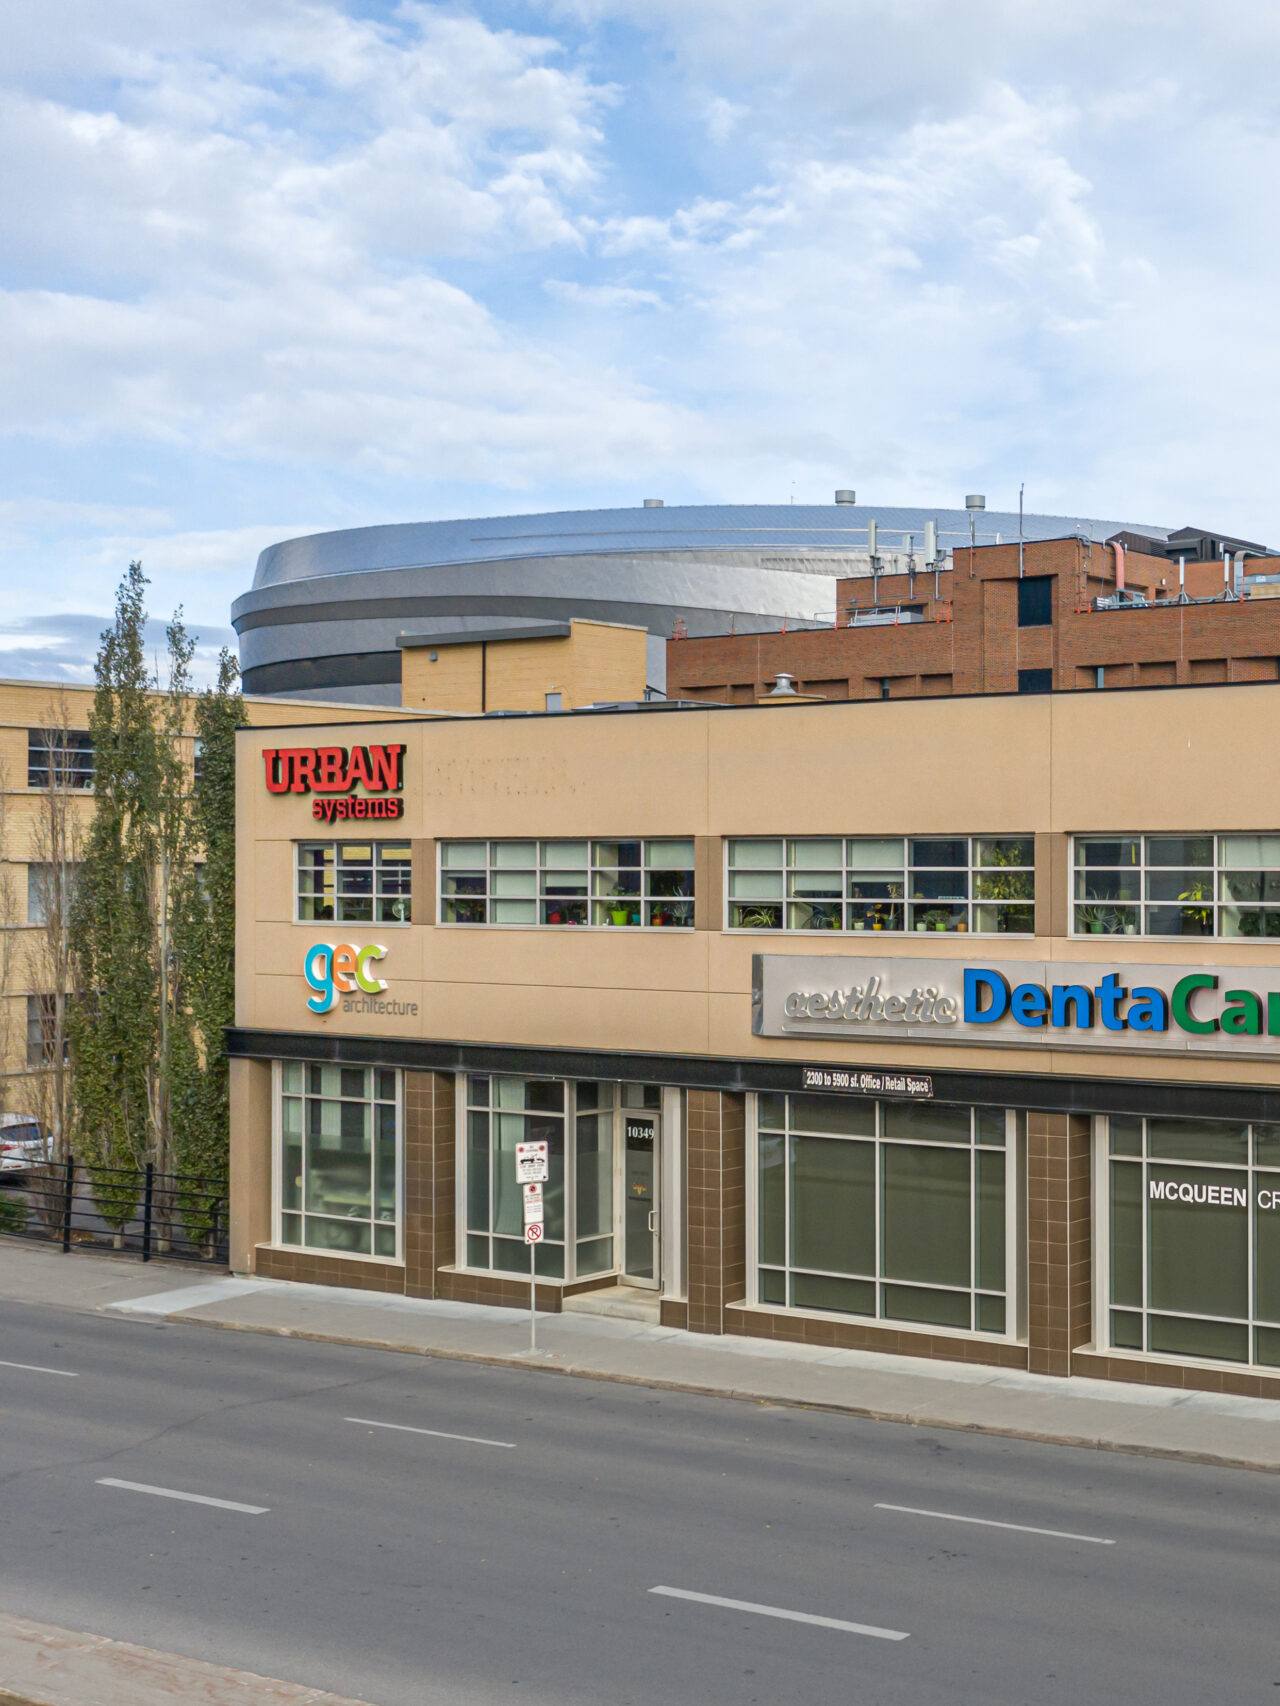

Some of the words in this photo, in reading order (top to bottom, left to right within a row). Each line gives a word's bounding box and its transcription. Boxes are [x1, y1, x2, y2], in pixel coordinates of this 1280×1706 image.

[262, 744, 406, 794] URBAN
[312, 795, 404, 825] systems
[303, 943, 390, 1014] gec
[343, 998, 418, 1016] architecture
[784, 976, 957, 1025] aesthetic
[806, 1071, 823, 1086] 2300
[824, 1073, 832, 1086] to
[832, 1073, 849, 1087] 5900
[860, 1074, 881, 1090] Office
[885, 1076, 906, 1091] Retail
[907, 1077, 929, 1094] Space
[627, 1126, 655, 1140] 10349
[1149, 1180, 1247, 1207] MCQUEEN
